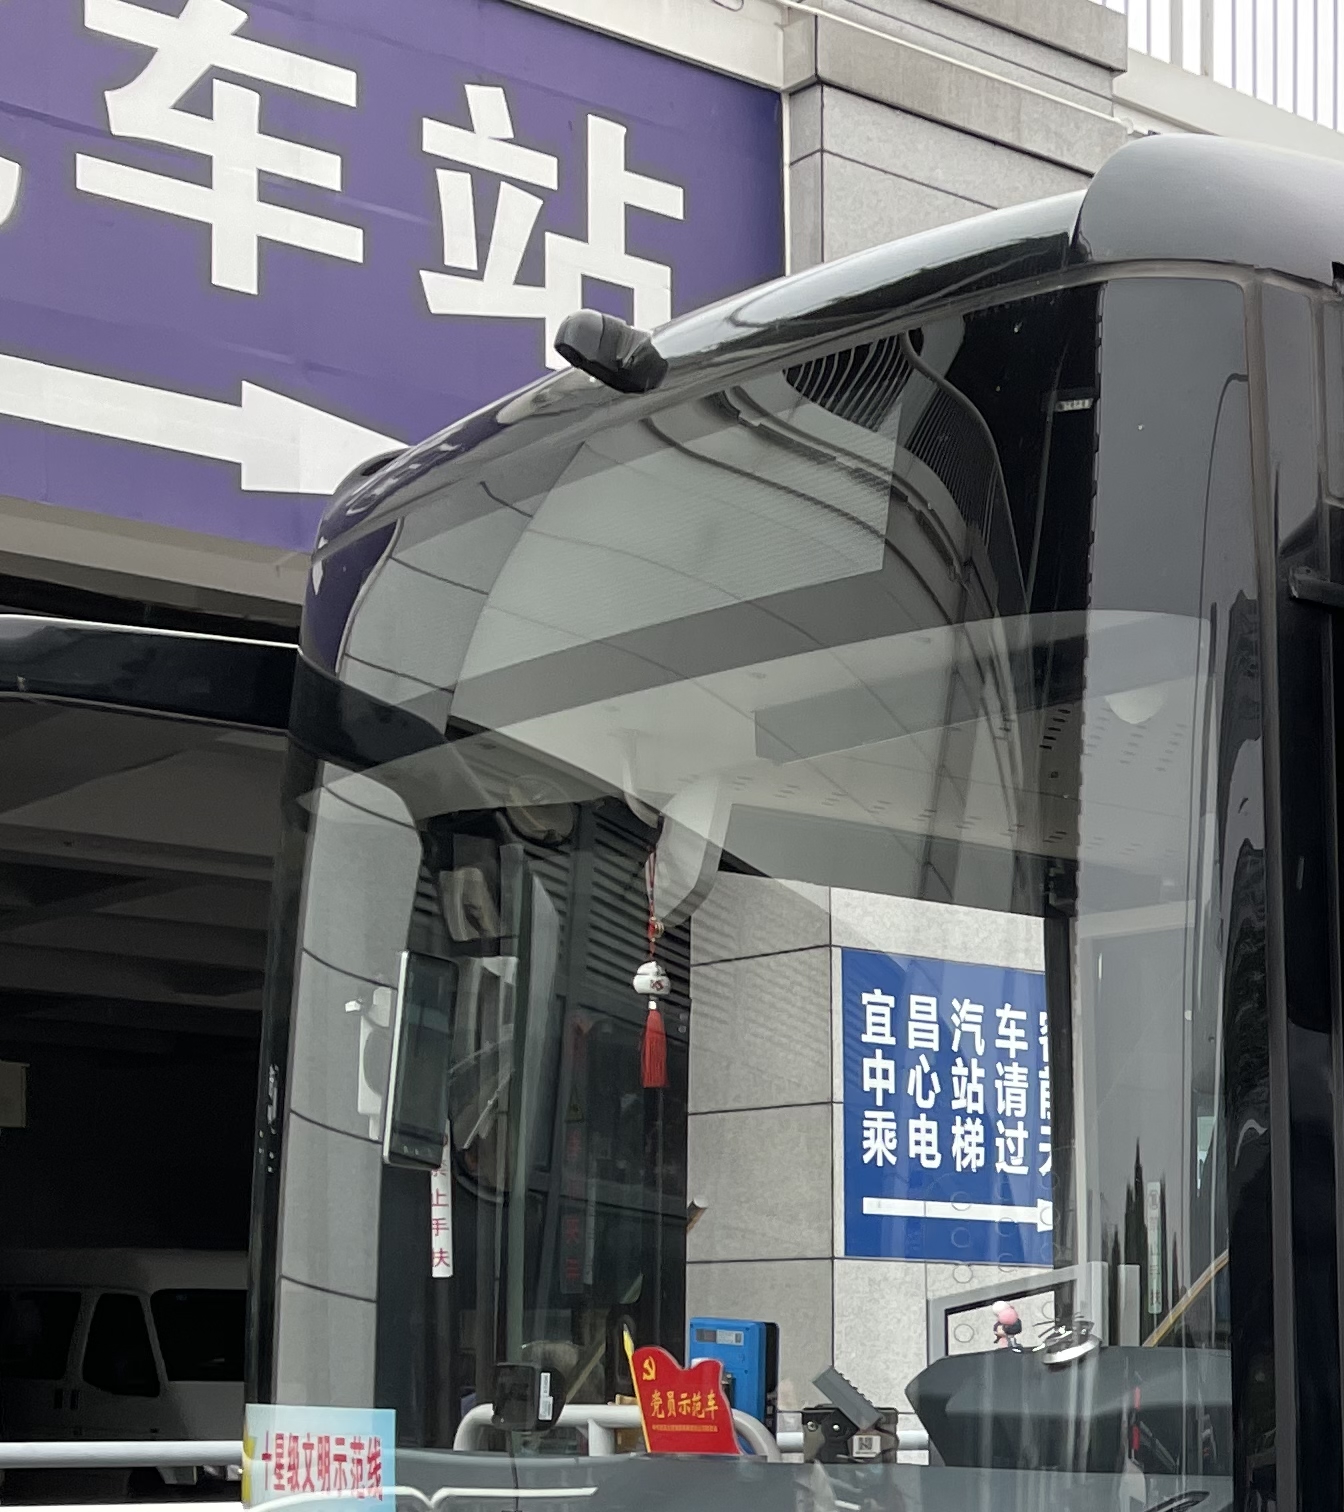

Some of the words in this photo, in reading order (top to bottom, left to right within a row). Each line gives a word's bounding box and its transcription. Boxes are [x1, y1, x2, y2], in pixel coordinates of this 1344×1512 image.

[0, 0, 684, 371] 车站
[650, 1389, 719, 1421] 党员示范车
[261, 1430, 384, 1501] 十星级文明示范线
